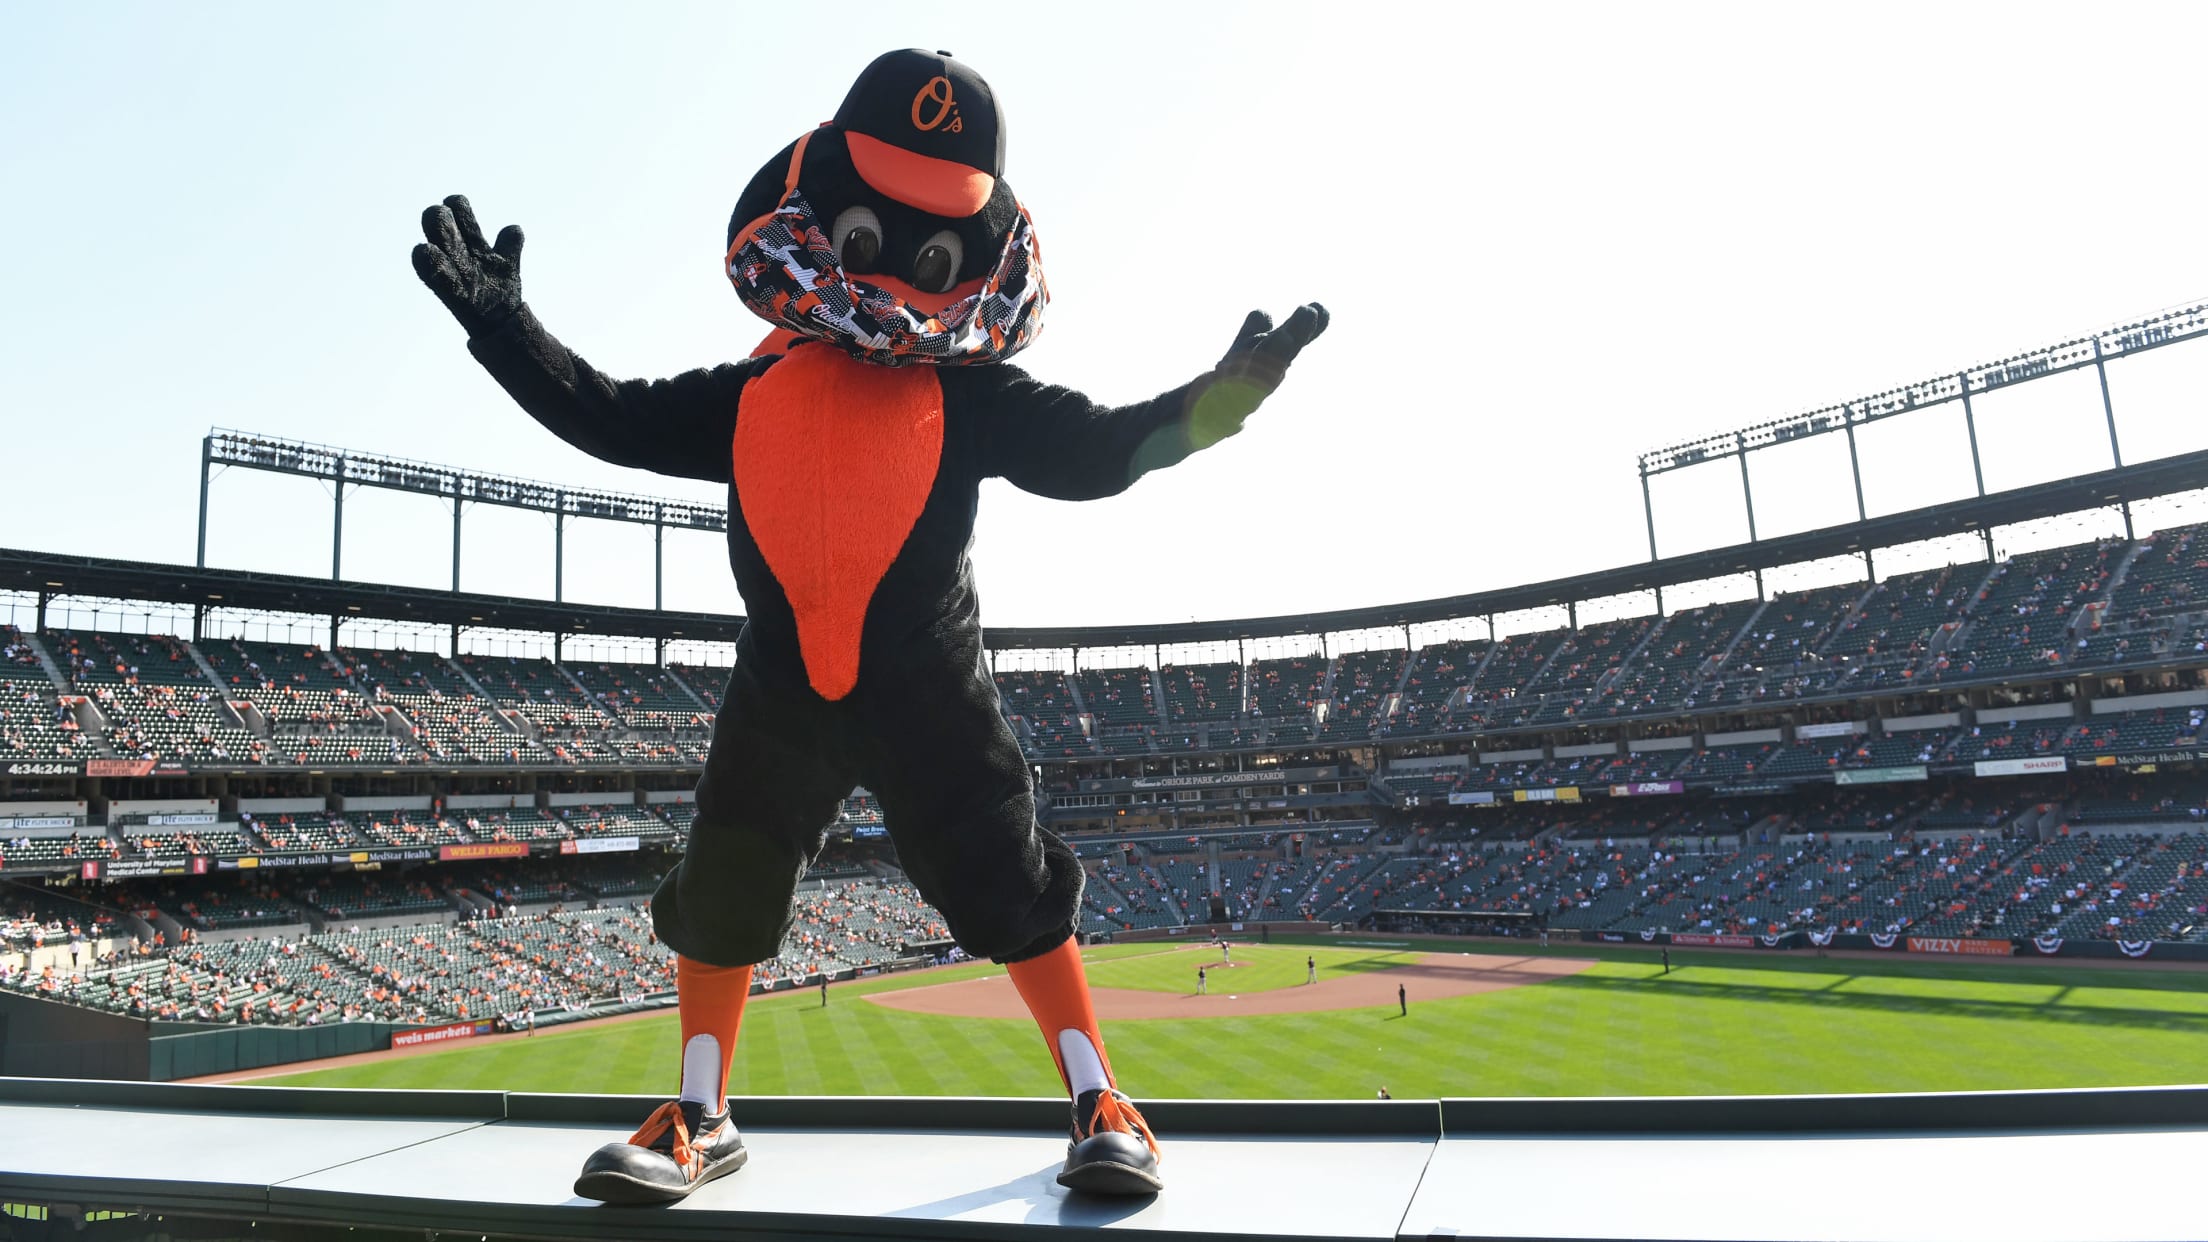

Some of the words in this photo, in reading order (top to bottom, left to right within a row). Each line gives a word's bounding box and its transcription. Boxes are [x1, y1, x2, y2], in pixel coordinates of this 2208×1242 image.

[911, 76, 963, 133] O's
[2118, 755, 2157, 765] MedStar
[2159, 752, 2192, 763] Health
[8, 763, 62, 775] 4:34:24
[63, 765, 78, 774] PM
[2023, 761, 2063, 770] SHARP
[1161, 777, 1192, 787] ORIOLE
[1192, 776, 1214, 785] PARK
[1222, 774, 1260, 783] CAMDEN
[1259, 772, 1285, 781] YARDS
[370, 851, 402, 861] MedStar
[404, 849, 431, 860] Health
[450, 846, 486, 857] WELLS
[488, 844, 521, 855] FARGO
[107, 860, 142, 869] University
[153, 859, 185, 867] Maryland
[260, 856, 297, 867] MedStar
[298, 854, 328, 865] Health
[1912, 938, 1961, 952] VIZZY
[396, 1033, 422, 1044] weis
[424, 1026, 471, 1041] markets
